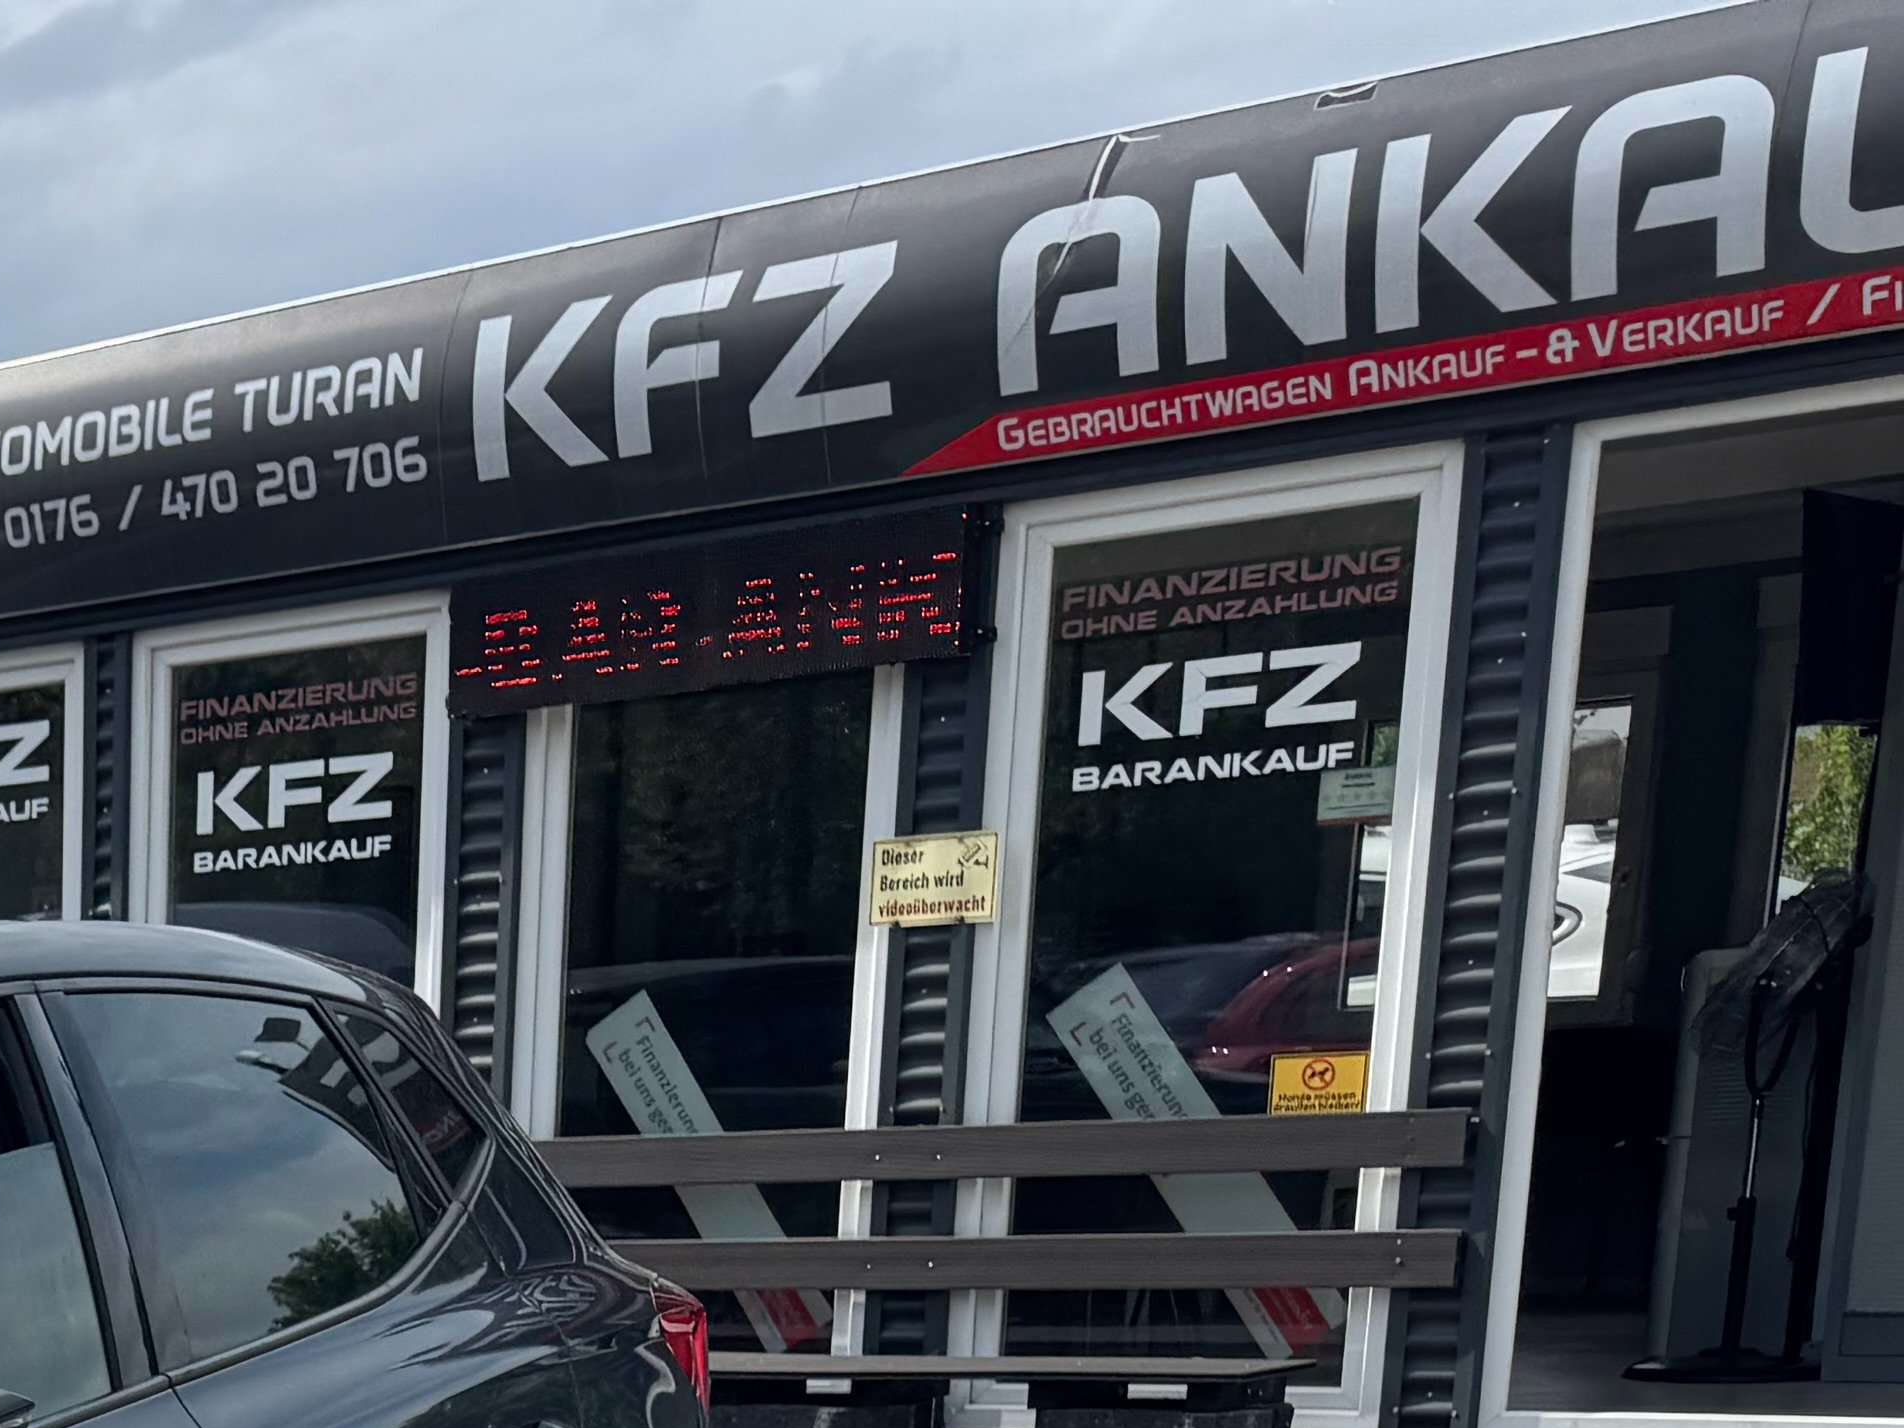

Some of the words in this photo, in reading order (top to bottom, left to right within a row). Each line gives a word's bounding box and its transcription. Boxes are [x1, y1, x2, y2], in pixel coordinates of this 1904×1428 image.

[475, 240, 897, 480] KFZ
[234, 348, 424, 434] TURAN
[5, 494, 101, 549] 0176
[160, 470, 238, 522] 470
[255, 456, 318, 508] 20
[333, 436, 429, 493] 706
[1061, 546, 1402, 613] FINANZIERUNG
[1060, 610, 1158, 640] OHNE
[1168, 581, 1399, 627] ANZAHLUNG
[180, 671, 418, 721] FINANZIERUNG
[180, 721, 249, 745] OHNE
[257, 701, 418, 738] ANZAHLUNG
[1078, 641, 1362, 747] KFZ
[196, 751, 394, 836] KFZ
[1072, 741, 1355, 792] BARANKAUF
[193, 834, 392, 874] BARANKAUF
[880, 872, 929, 892] Bereich
[933, 869, 964, 888] wird
[882, 848, 924, 866] Dieser
[879, 894, 985, 917] videoüberwacht
[618, 1048, 641, 1078] bei
[633, 1079, 656, 1107] uns
[1089, 1027, 1118, 1061] bei
[1107, 1062, 1135, 1094] uns
